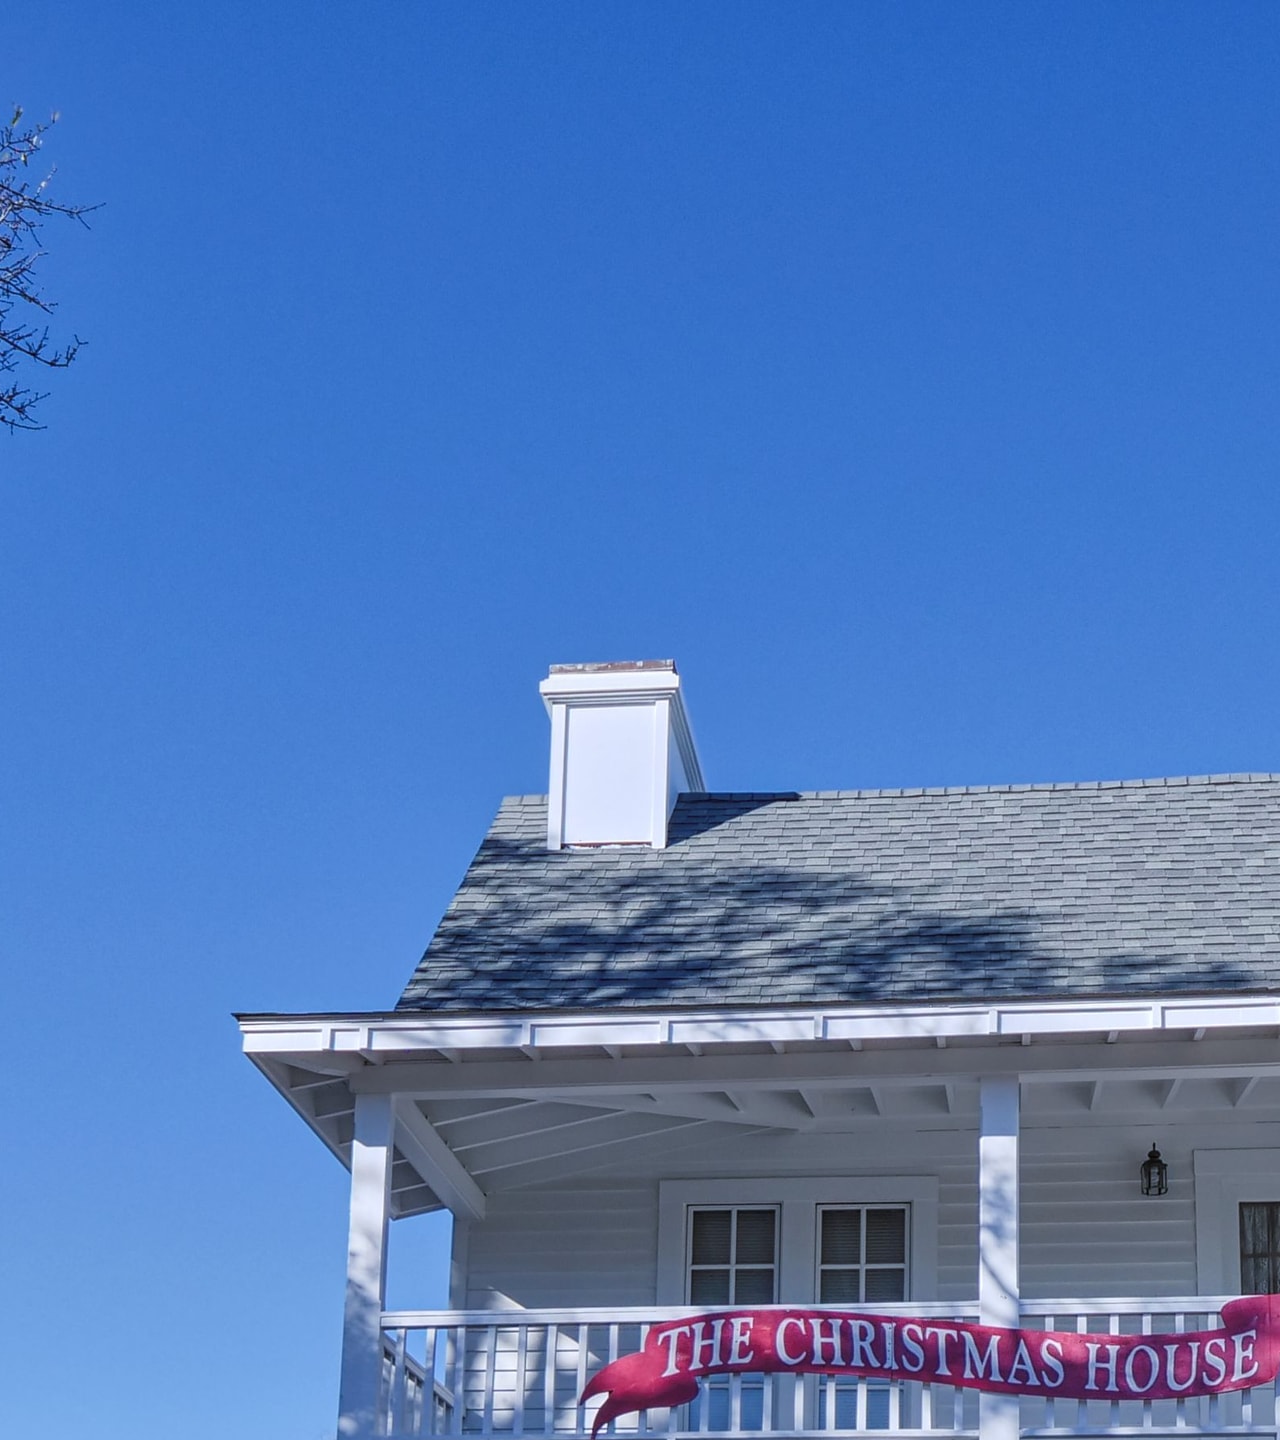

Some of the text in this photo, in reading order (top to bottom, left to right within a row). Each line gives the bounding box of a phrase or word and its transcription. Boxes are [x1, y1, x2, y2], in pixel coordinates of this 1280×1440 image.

[657, 1317, 1258, 1393] THE CHRISTMAS HOUSE
